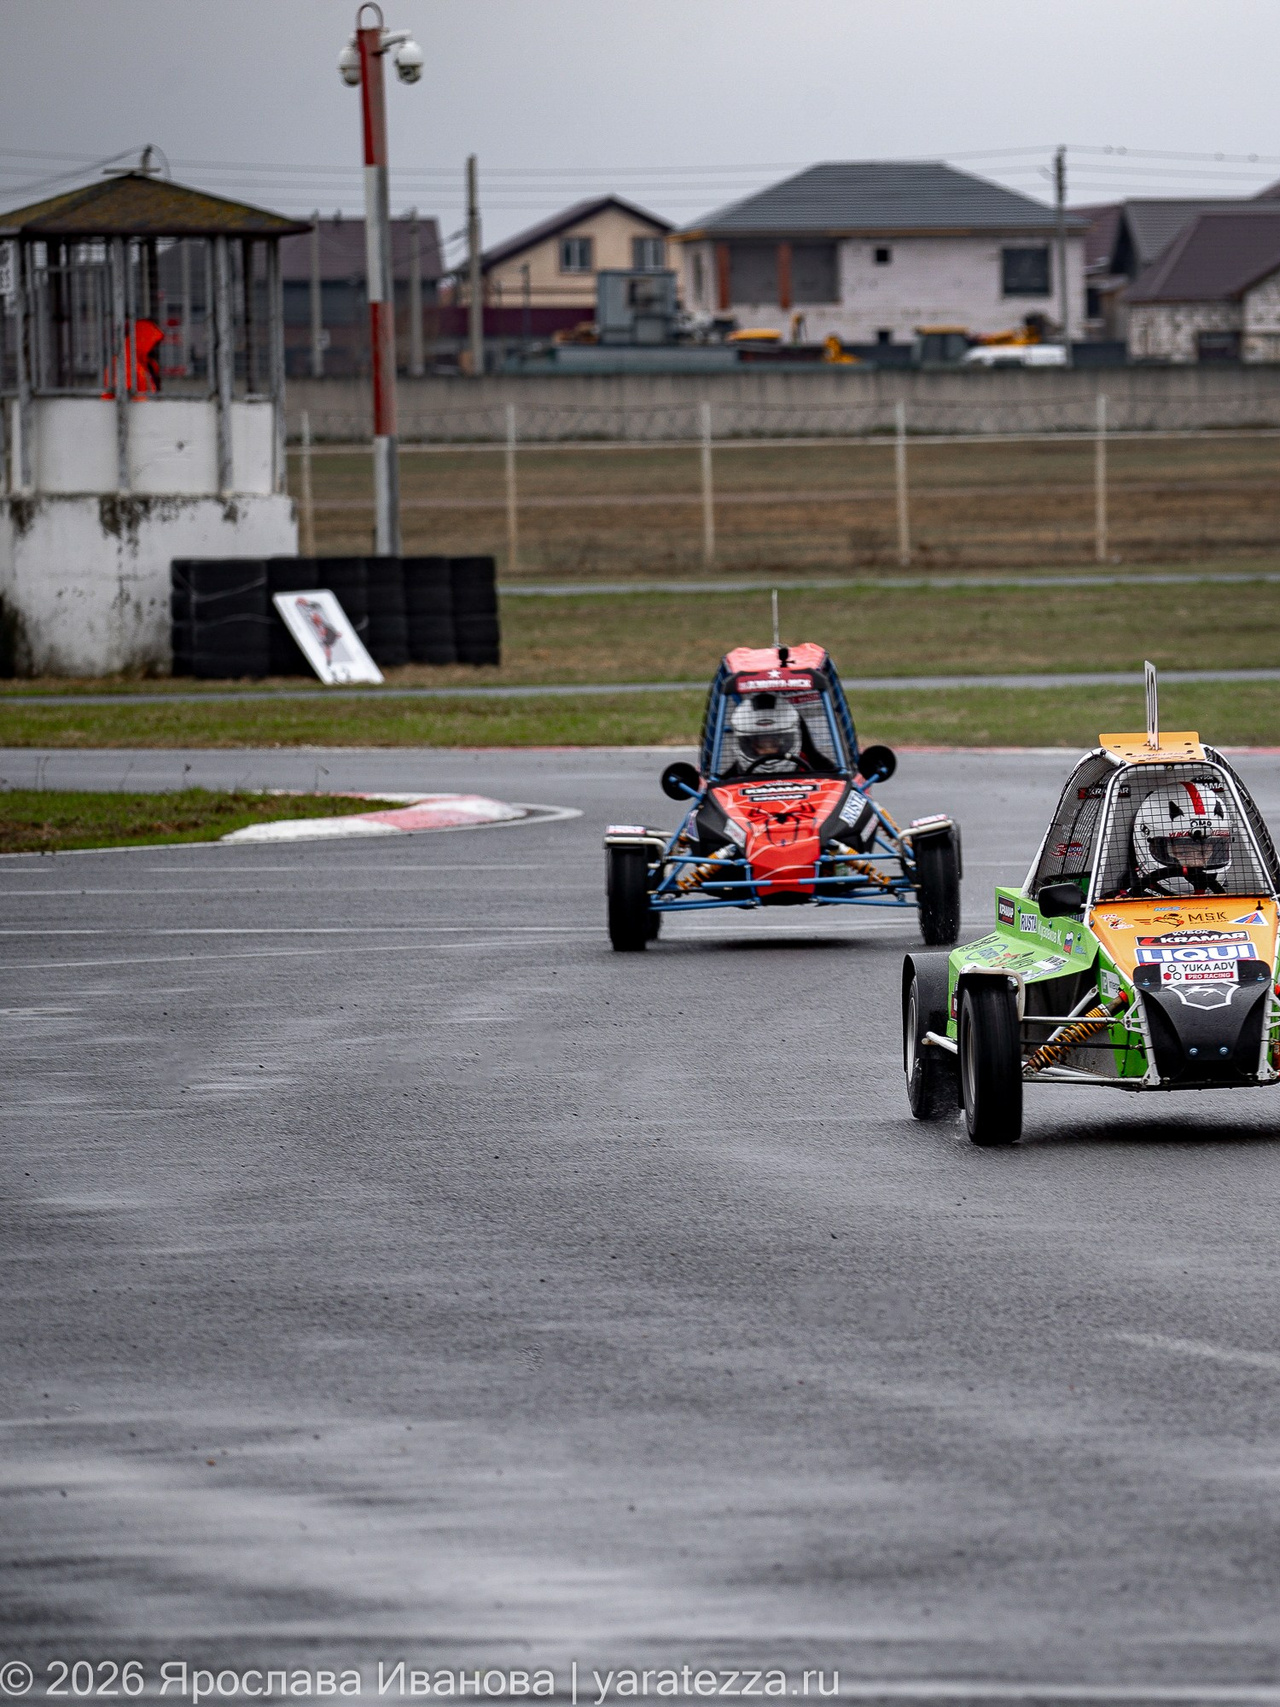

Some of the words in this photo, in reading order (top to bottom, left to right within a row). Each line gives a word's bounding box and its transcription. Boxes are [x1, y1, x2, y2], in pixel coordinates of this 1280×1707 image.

[1188, 911, 1227, 922] MSK
[1160, 932, 1246, 944] KRAMAR
[1142, 945, 1251, 962] LIQUI
[1182, 963, 1213, 972] YUKA
[1213, 961, 1236, 971] ADV
